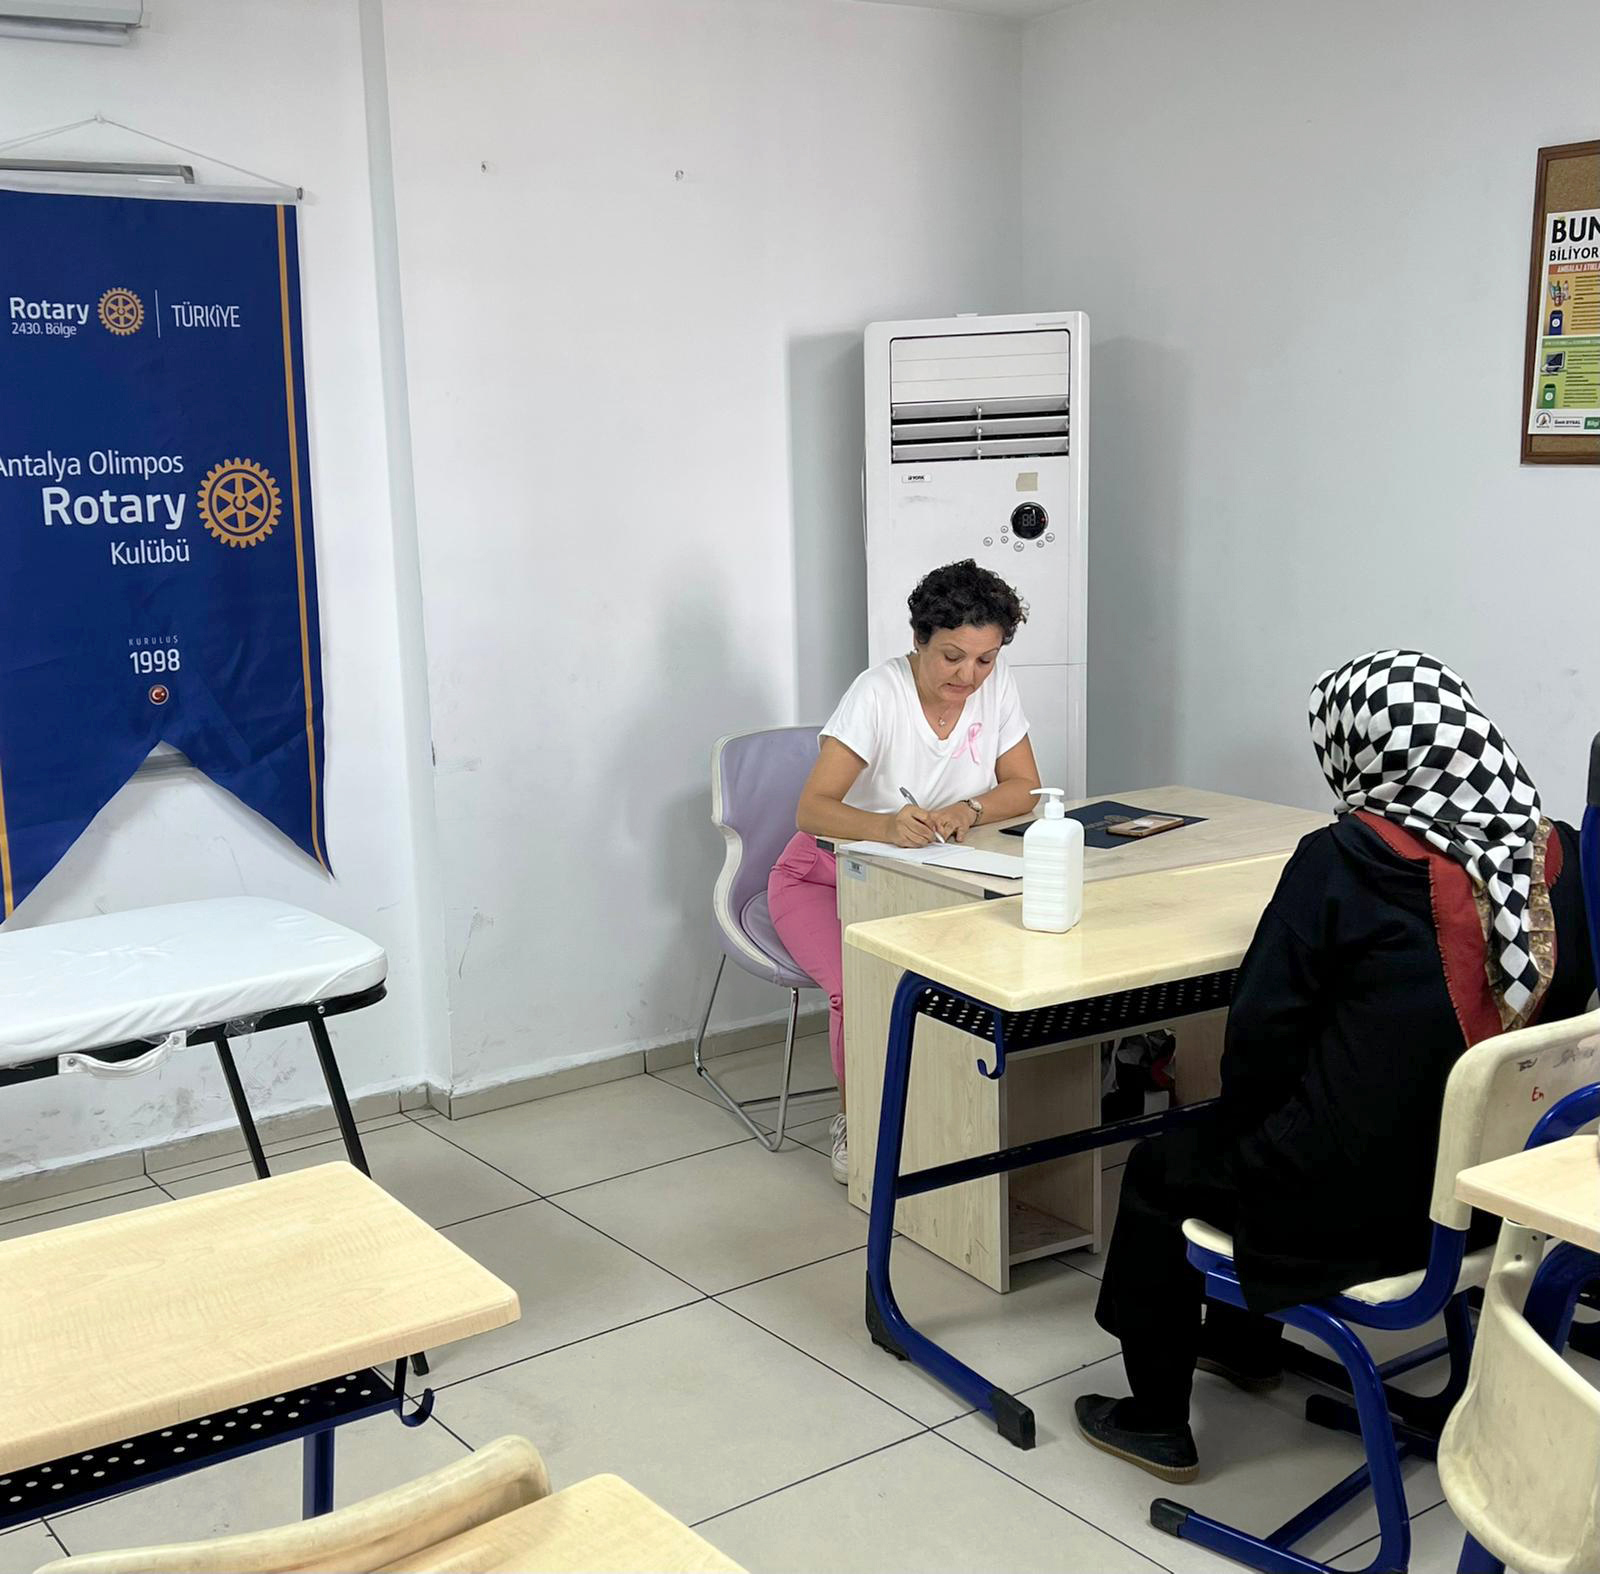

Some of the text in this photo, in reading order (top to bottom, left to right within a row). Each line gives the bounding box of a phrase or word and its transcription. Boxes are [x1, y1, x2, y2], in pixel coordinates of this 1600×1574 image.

[9, 296, 89, 325] Rotary
[171, 301, 241, 328] TÜRKİYE
[12, 321, 77, 338] 2430. Bölge
[88, 450, 184, 480] Olimpos
[42, 486, 186, 530] Rotary
[110, 538, 190, 565] Kulübü
[129, 648, 181, 674] 1998
